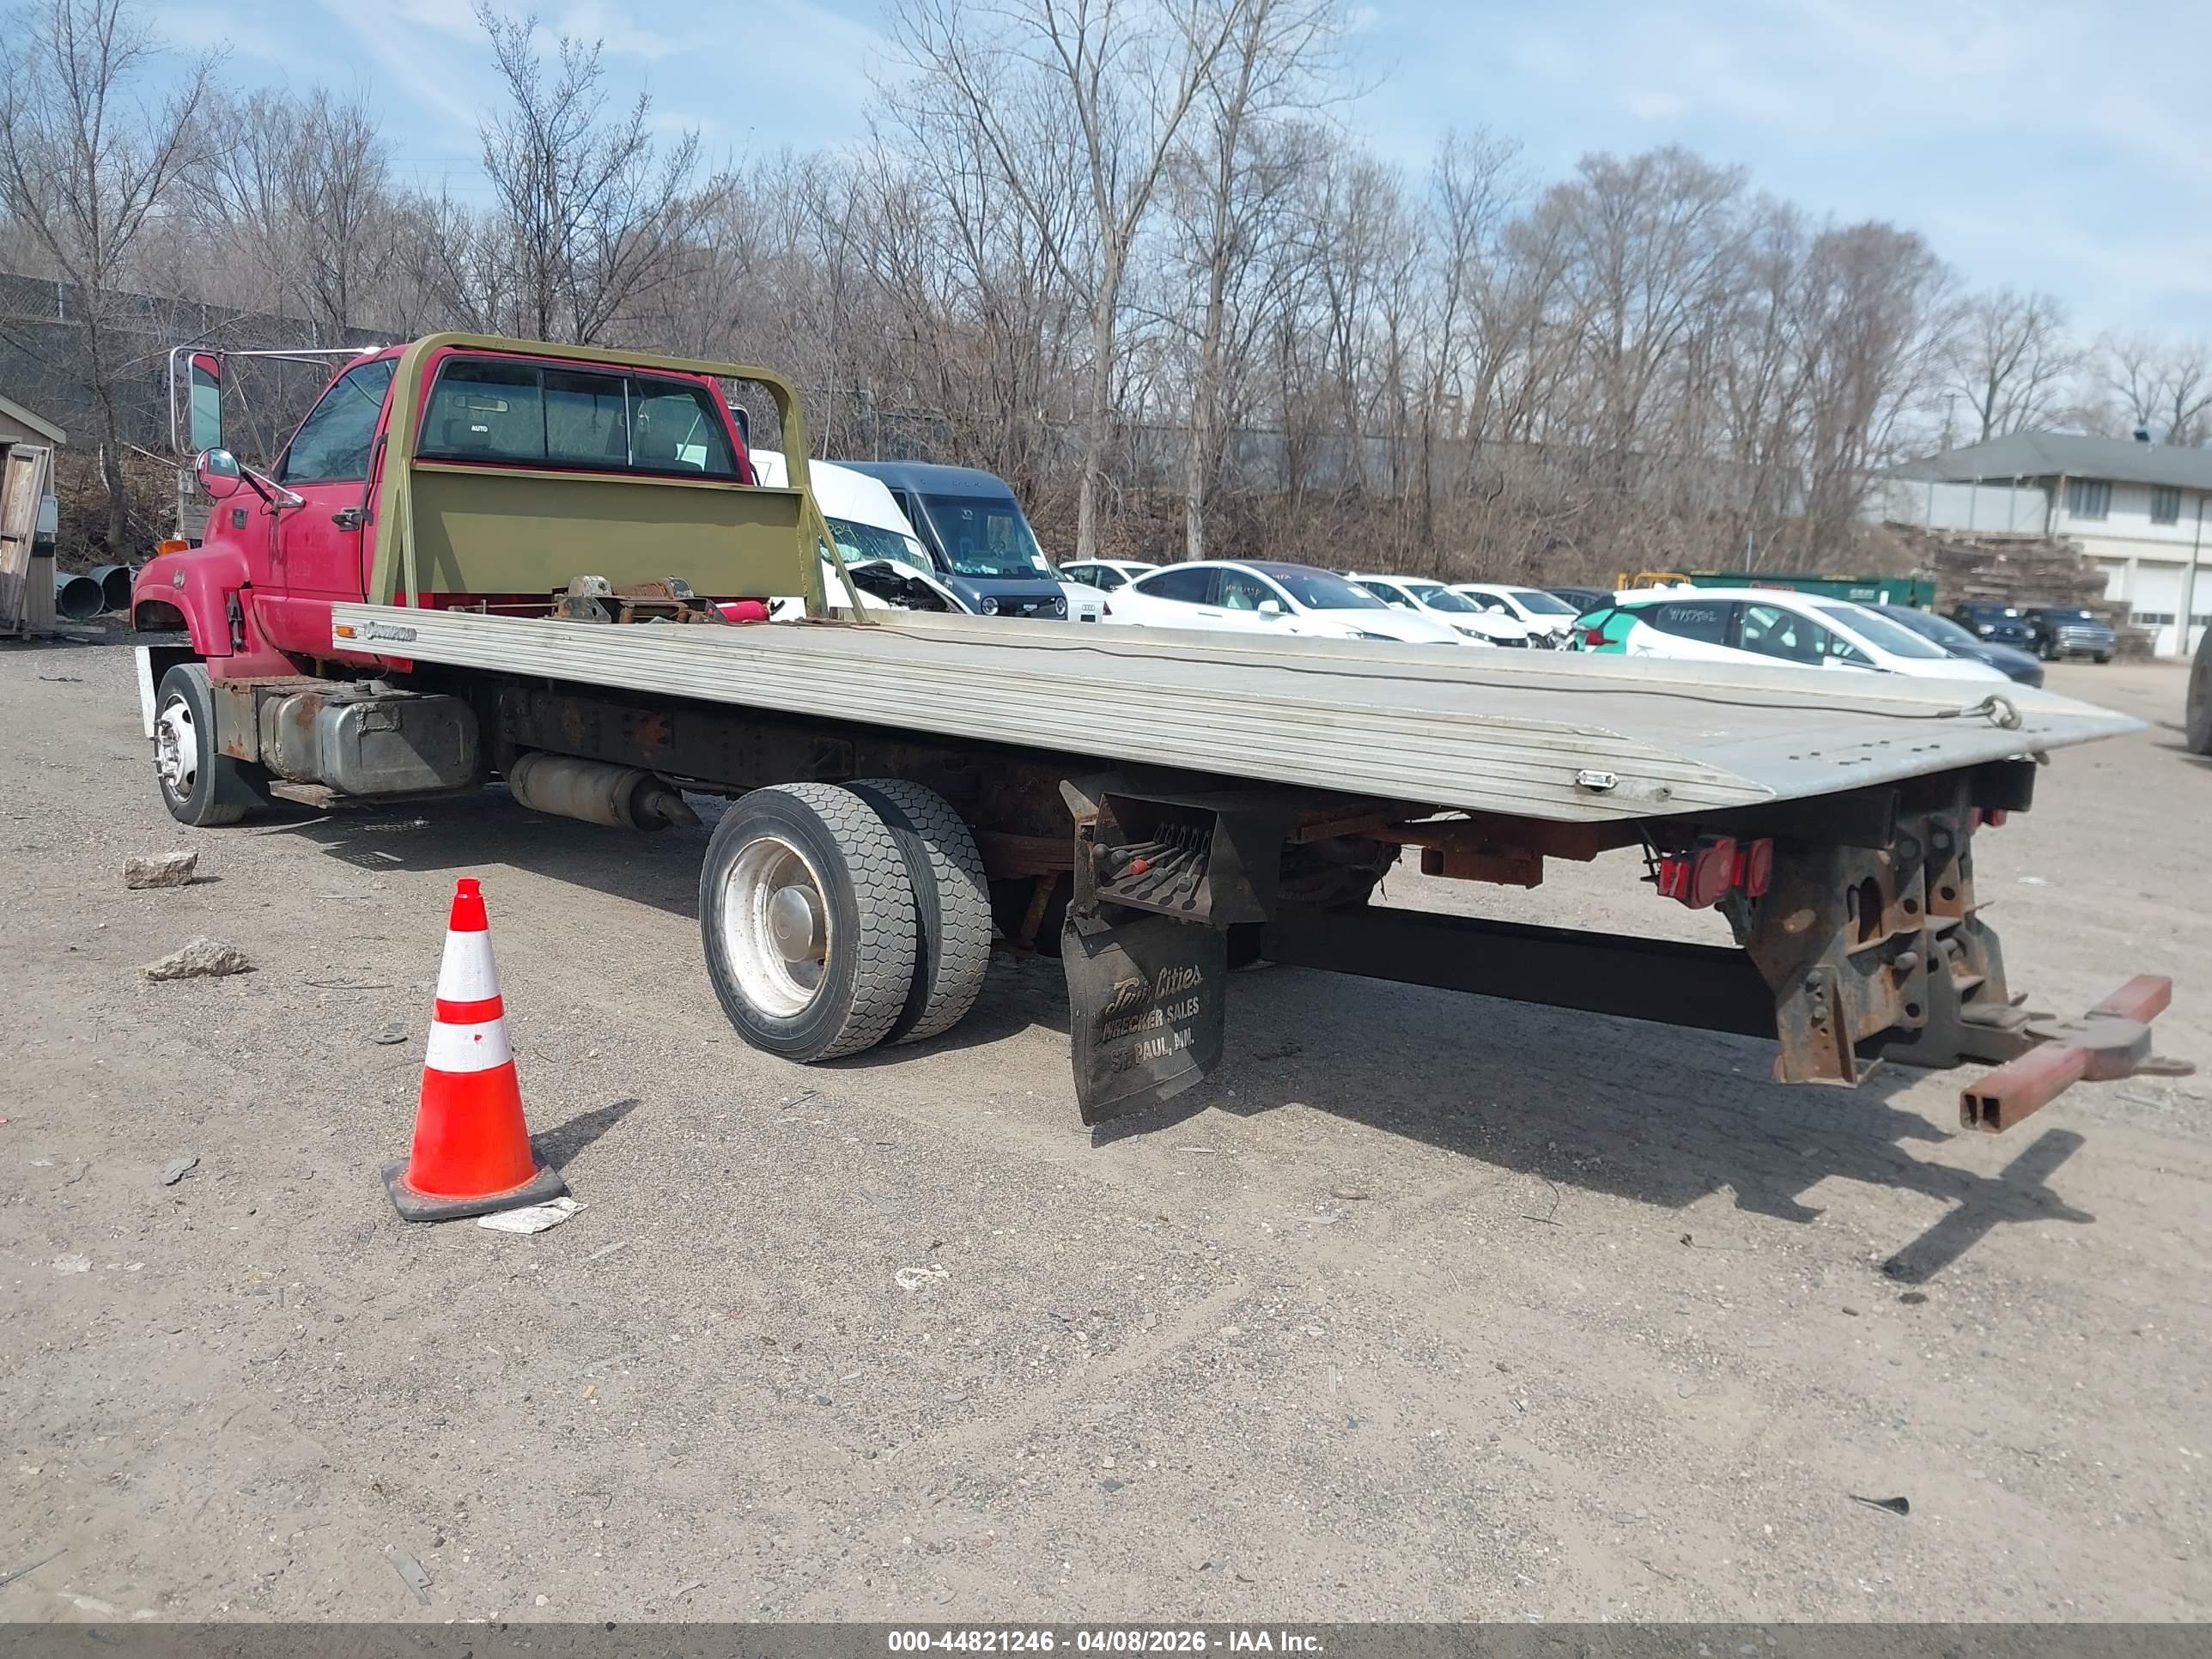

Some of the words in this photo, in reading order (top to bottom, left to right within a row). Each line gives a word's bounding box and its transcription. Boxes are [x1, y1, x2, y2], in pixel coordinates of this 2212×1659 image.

[1154, 964, 1203, 999] Cities
[1103, 1009, 1164, 1043] WRECKER
[1166, 996, 1200, 1024] SALES
[1133, 1036, 1173, 1065] PAUL,
[1174, 1027, 1195, 1051] MN.
